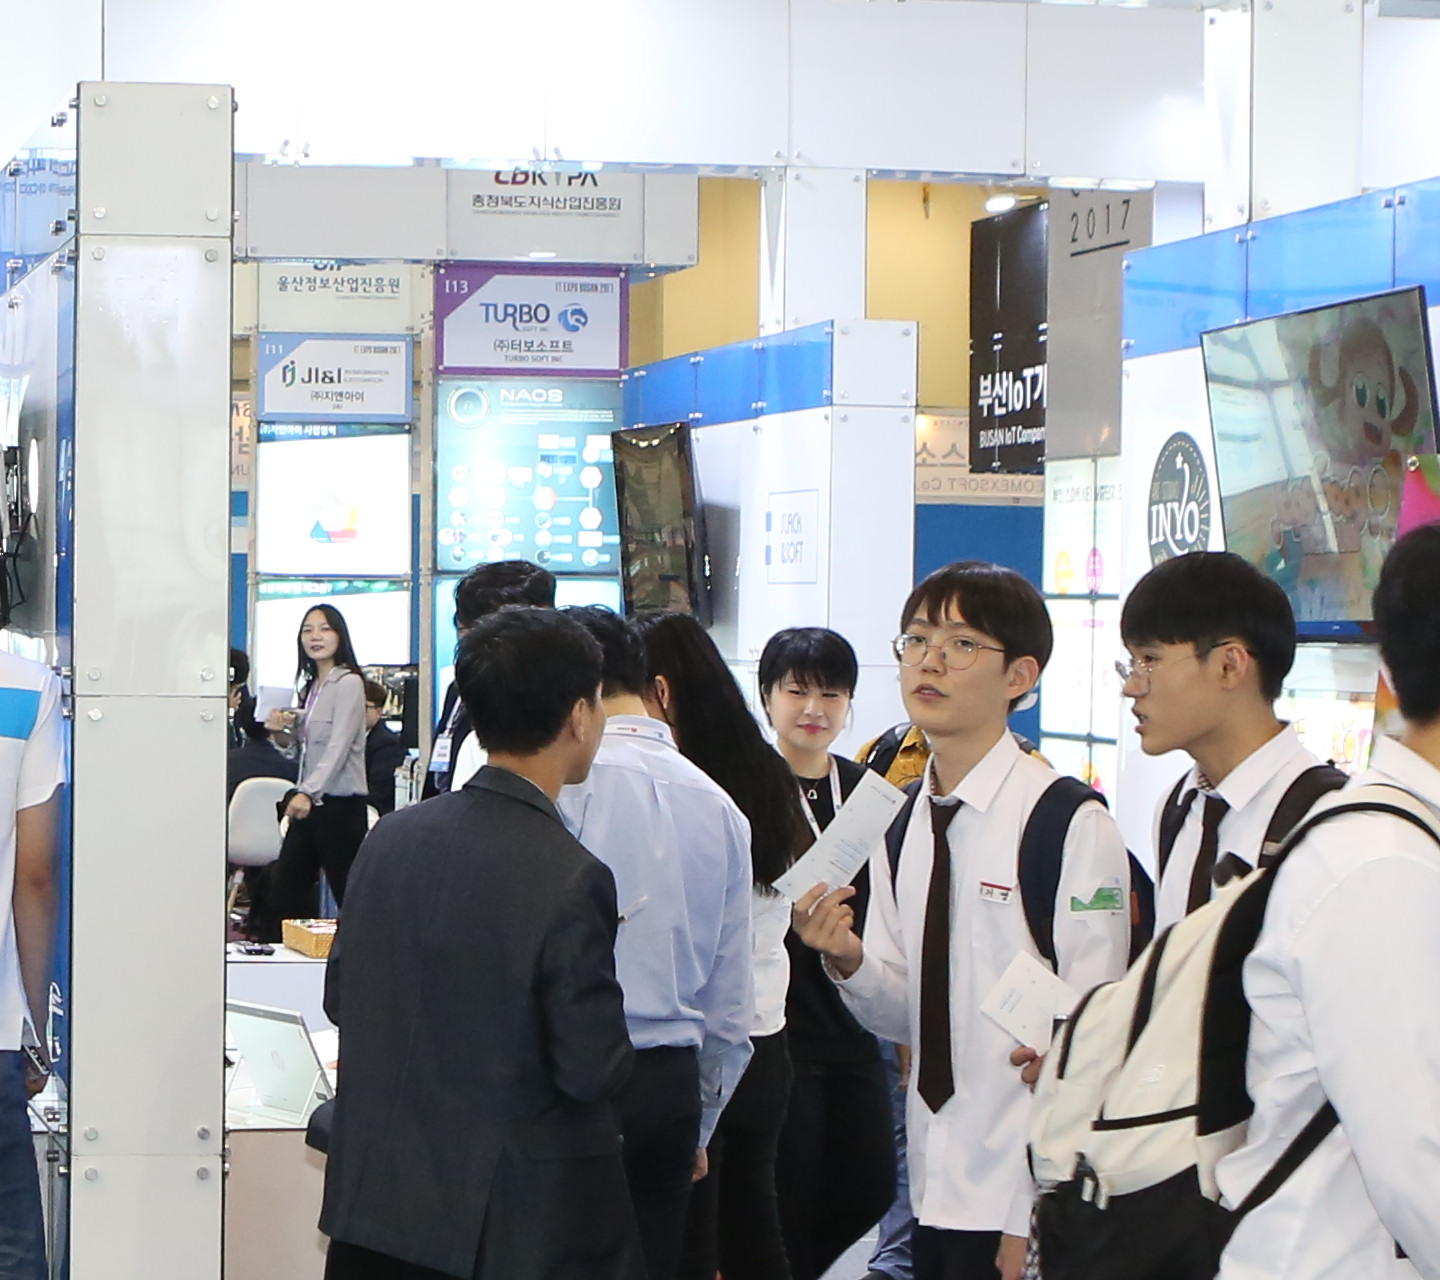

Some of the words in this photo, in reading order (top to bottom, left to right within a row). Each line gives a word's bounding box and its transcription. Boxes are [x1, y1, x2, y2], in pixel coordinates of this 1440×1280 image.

[1071, 199, 1131, 243] 2017
[277, 276, 400, 294] 울산정보산업진흥원
[480, 303, 550, 331] TURBO
[493, 339, 573, 353] (주)터보소프트
[500, 389, 563, 402] NAOS
